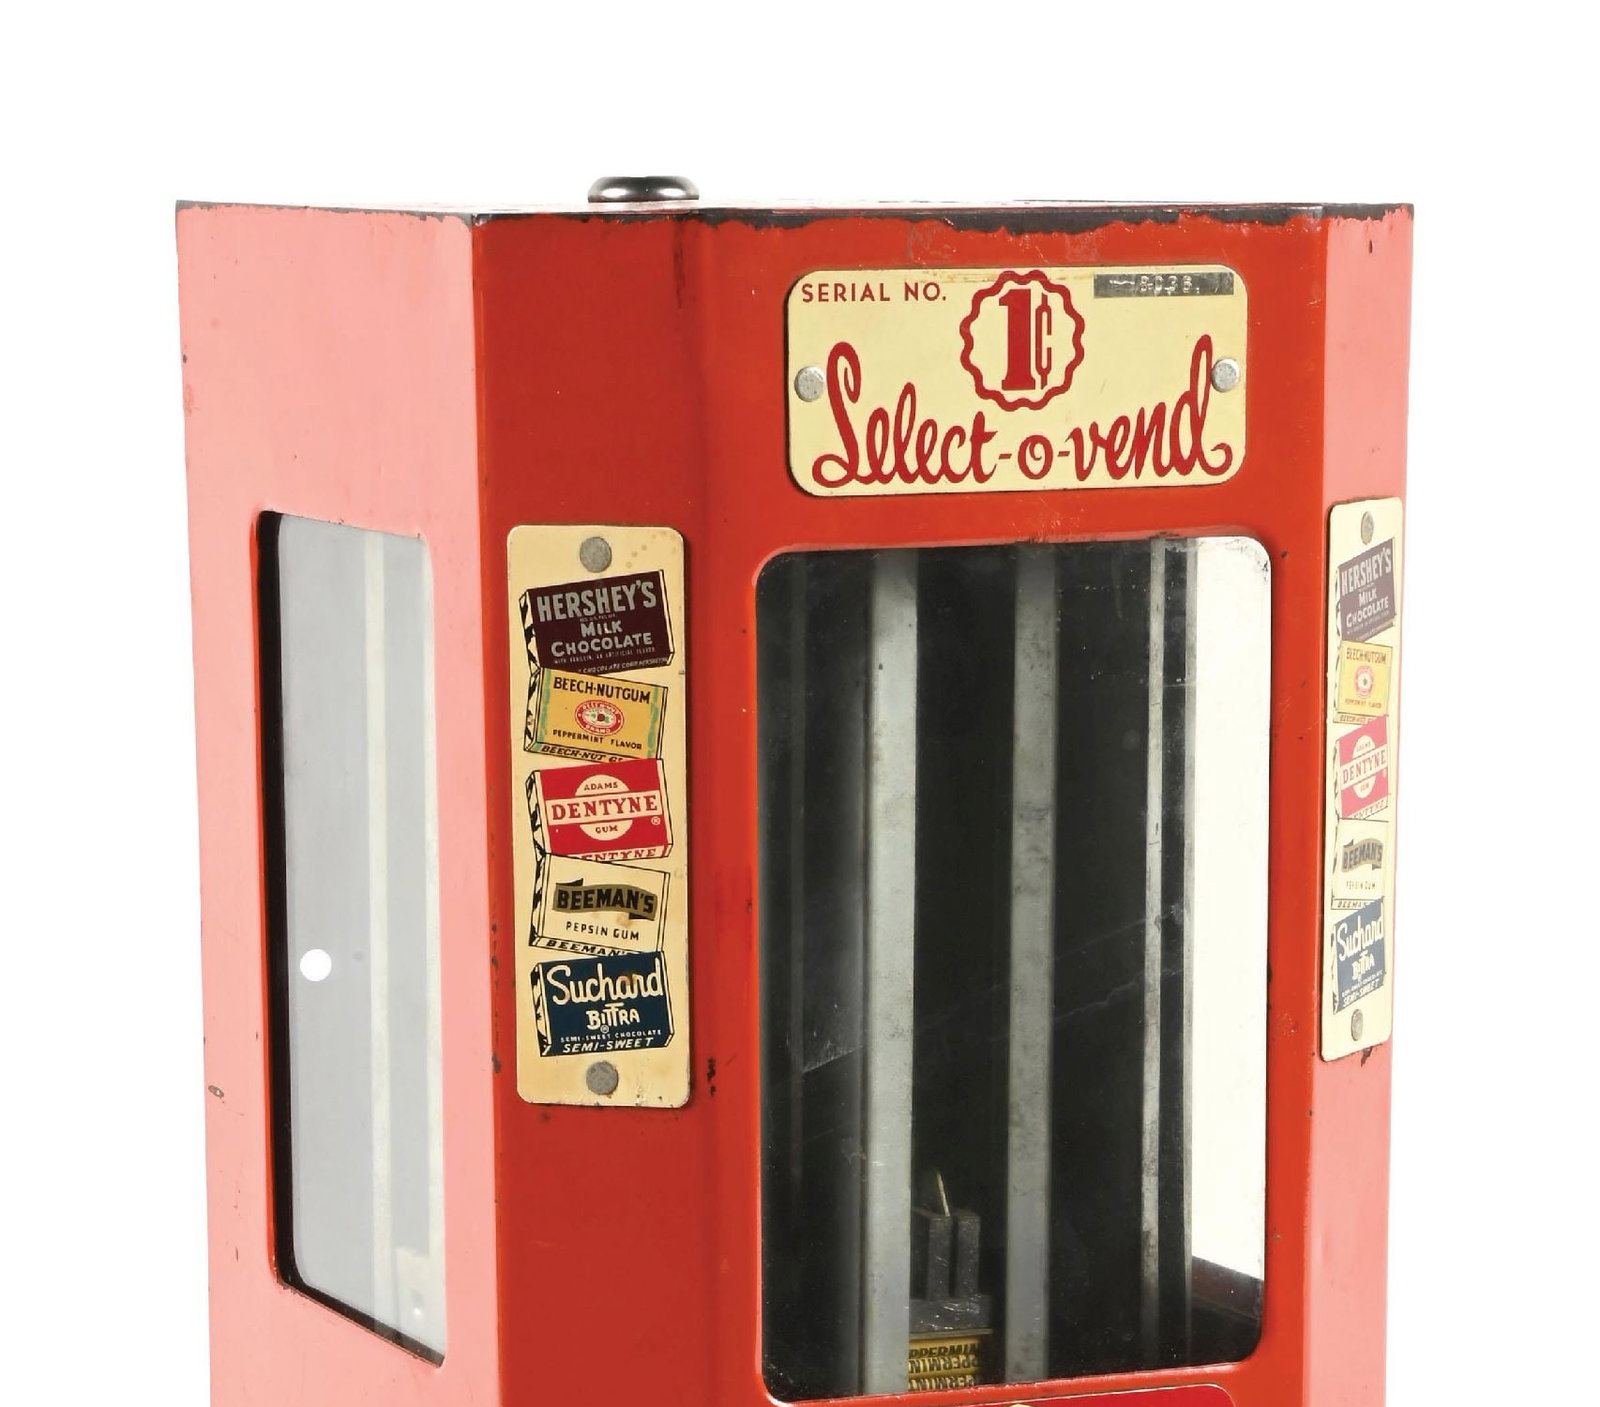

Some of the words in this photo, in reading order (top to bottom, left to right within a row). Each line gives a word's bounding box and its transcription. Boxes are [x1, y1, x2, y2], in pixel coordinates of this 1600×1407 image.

[802, 283, 890, 303] SERIAL
[904, 281, 948, 302] NO.
[811, 333, 1233, 489] Select-o-vend
[1341, 546, 1392, 597] HERSHEY'S
[536, 579, 657, 622] HERSHEY'S
[1358, 587, 1377, 607] MILK
[1346, 595, 1389, 628] CHOCOLATE
[580, 620, 623, 638] MILK
[551, 632, 653, 658] CHOCOLATE
[552, 729, 604, 744] PEPPERMINT
[610, 738, 642, 750] FLAVOR
[541, 744, 607, 761] BEECH-NUT
[1342, 748, 1386, 785] DENTYNE
[583, 781, 619, 791] ADAMS
[551, 794, 658, 821] DENTYNE
[595, 825, 618, 834] GUM
[580, 848, 657, 862] ENTYNE
[556, 887, 655, 914] BEEMAN'S
[565, 921, 608, 937] PEPSIN
[613, 928, 640, 941] GUM
[1336, 914, 1384, 962] Suchard
[545, 939, 634, 957] BEEMAN'
[546, 957, 664, 1006] Suchard
[614, 1029, 662, 1039] CHOCOLATE
[562, 1037, 654, 1053] SEMI-SWEET
